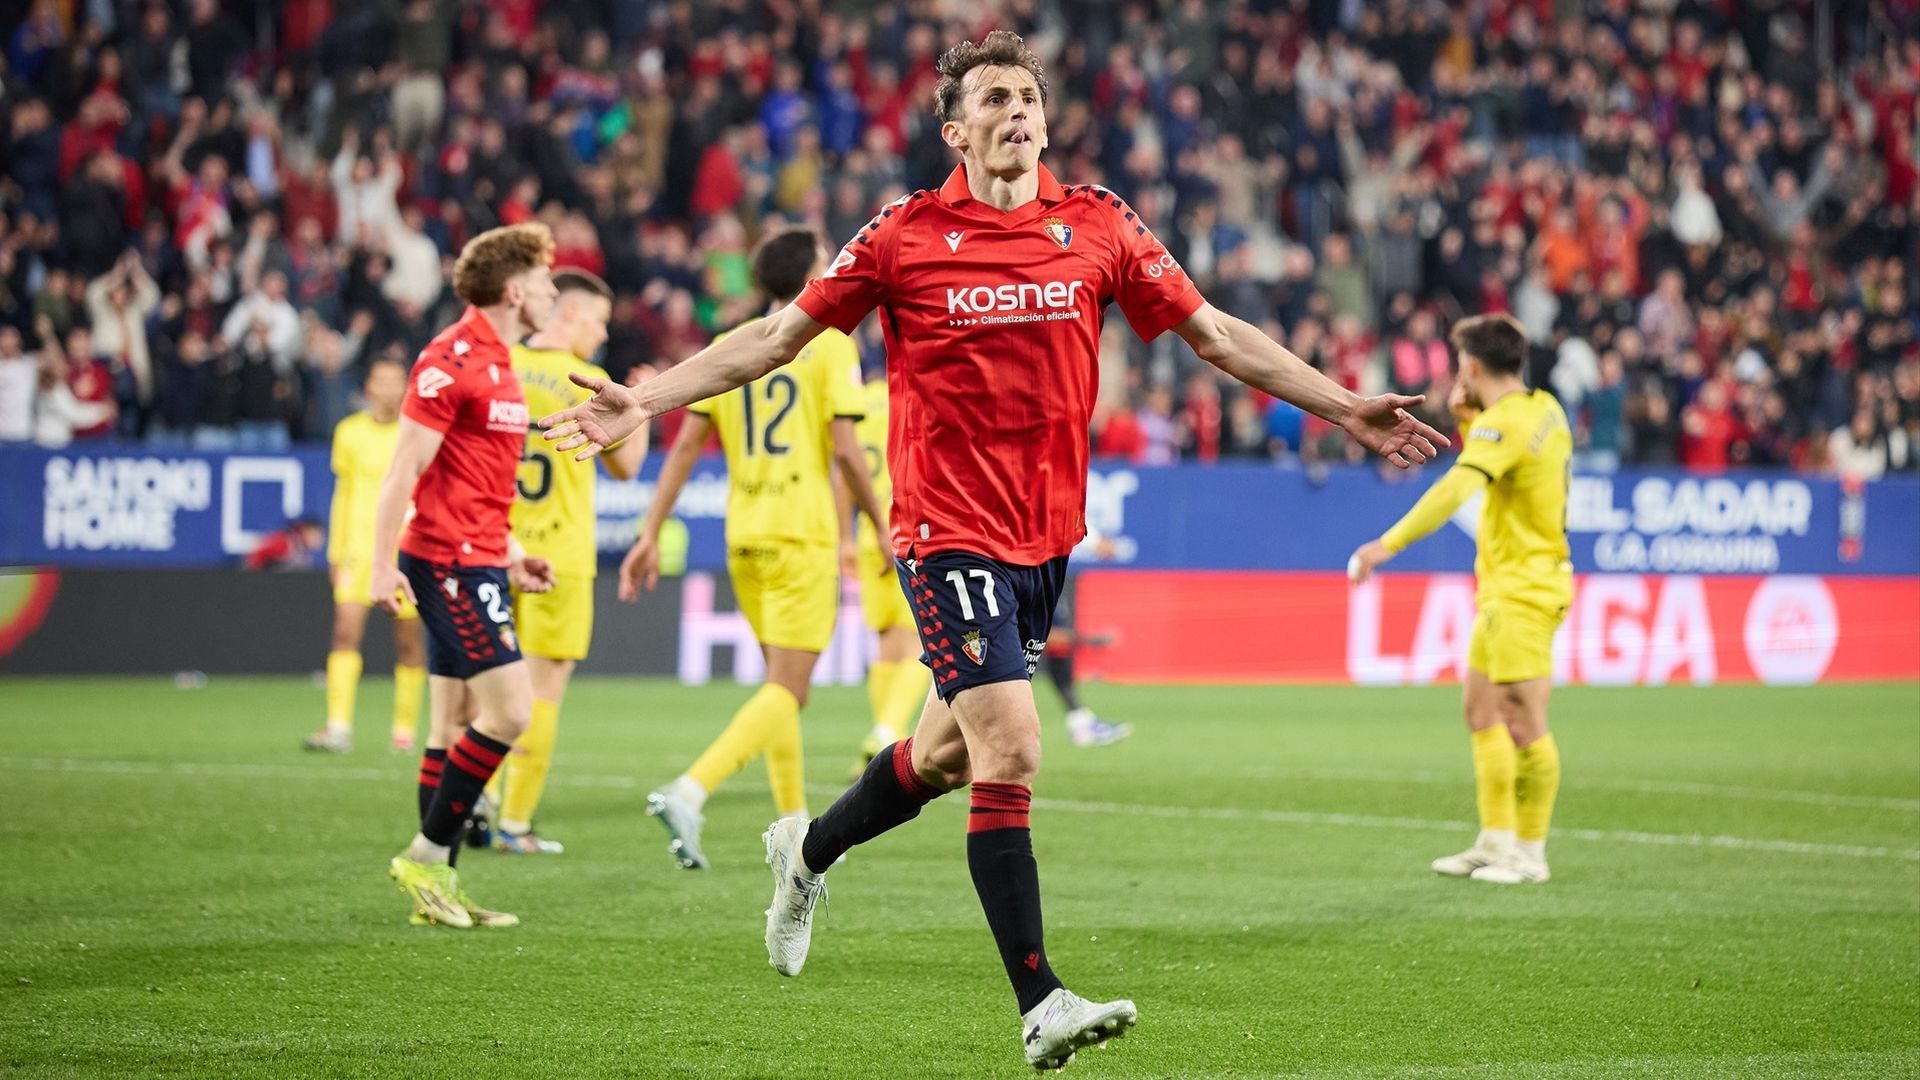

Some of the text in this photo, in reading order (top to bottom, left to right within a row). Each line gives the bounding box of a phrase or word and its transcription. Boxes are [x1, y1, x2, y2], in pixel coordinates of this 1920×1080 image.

[980, 313, 1045, 325] Climatización
[743, 373, 797, 456] 12
[44, 502, 175, 549] HOME
[1568, 476, 1812, 535] EL SADAR
[945, 569, 1000, 621] 17
